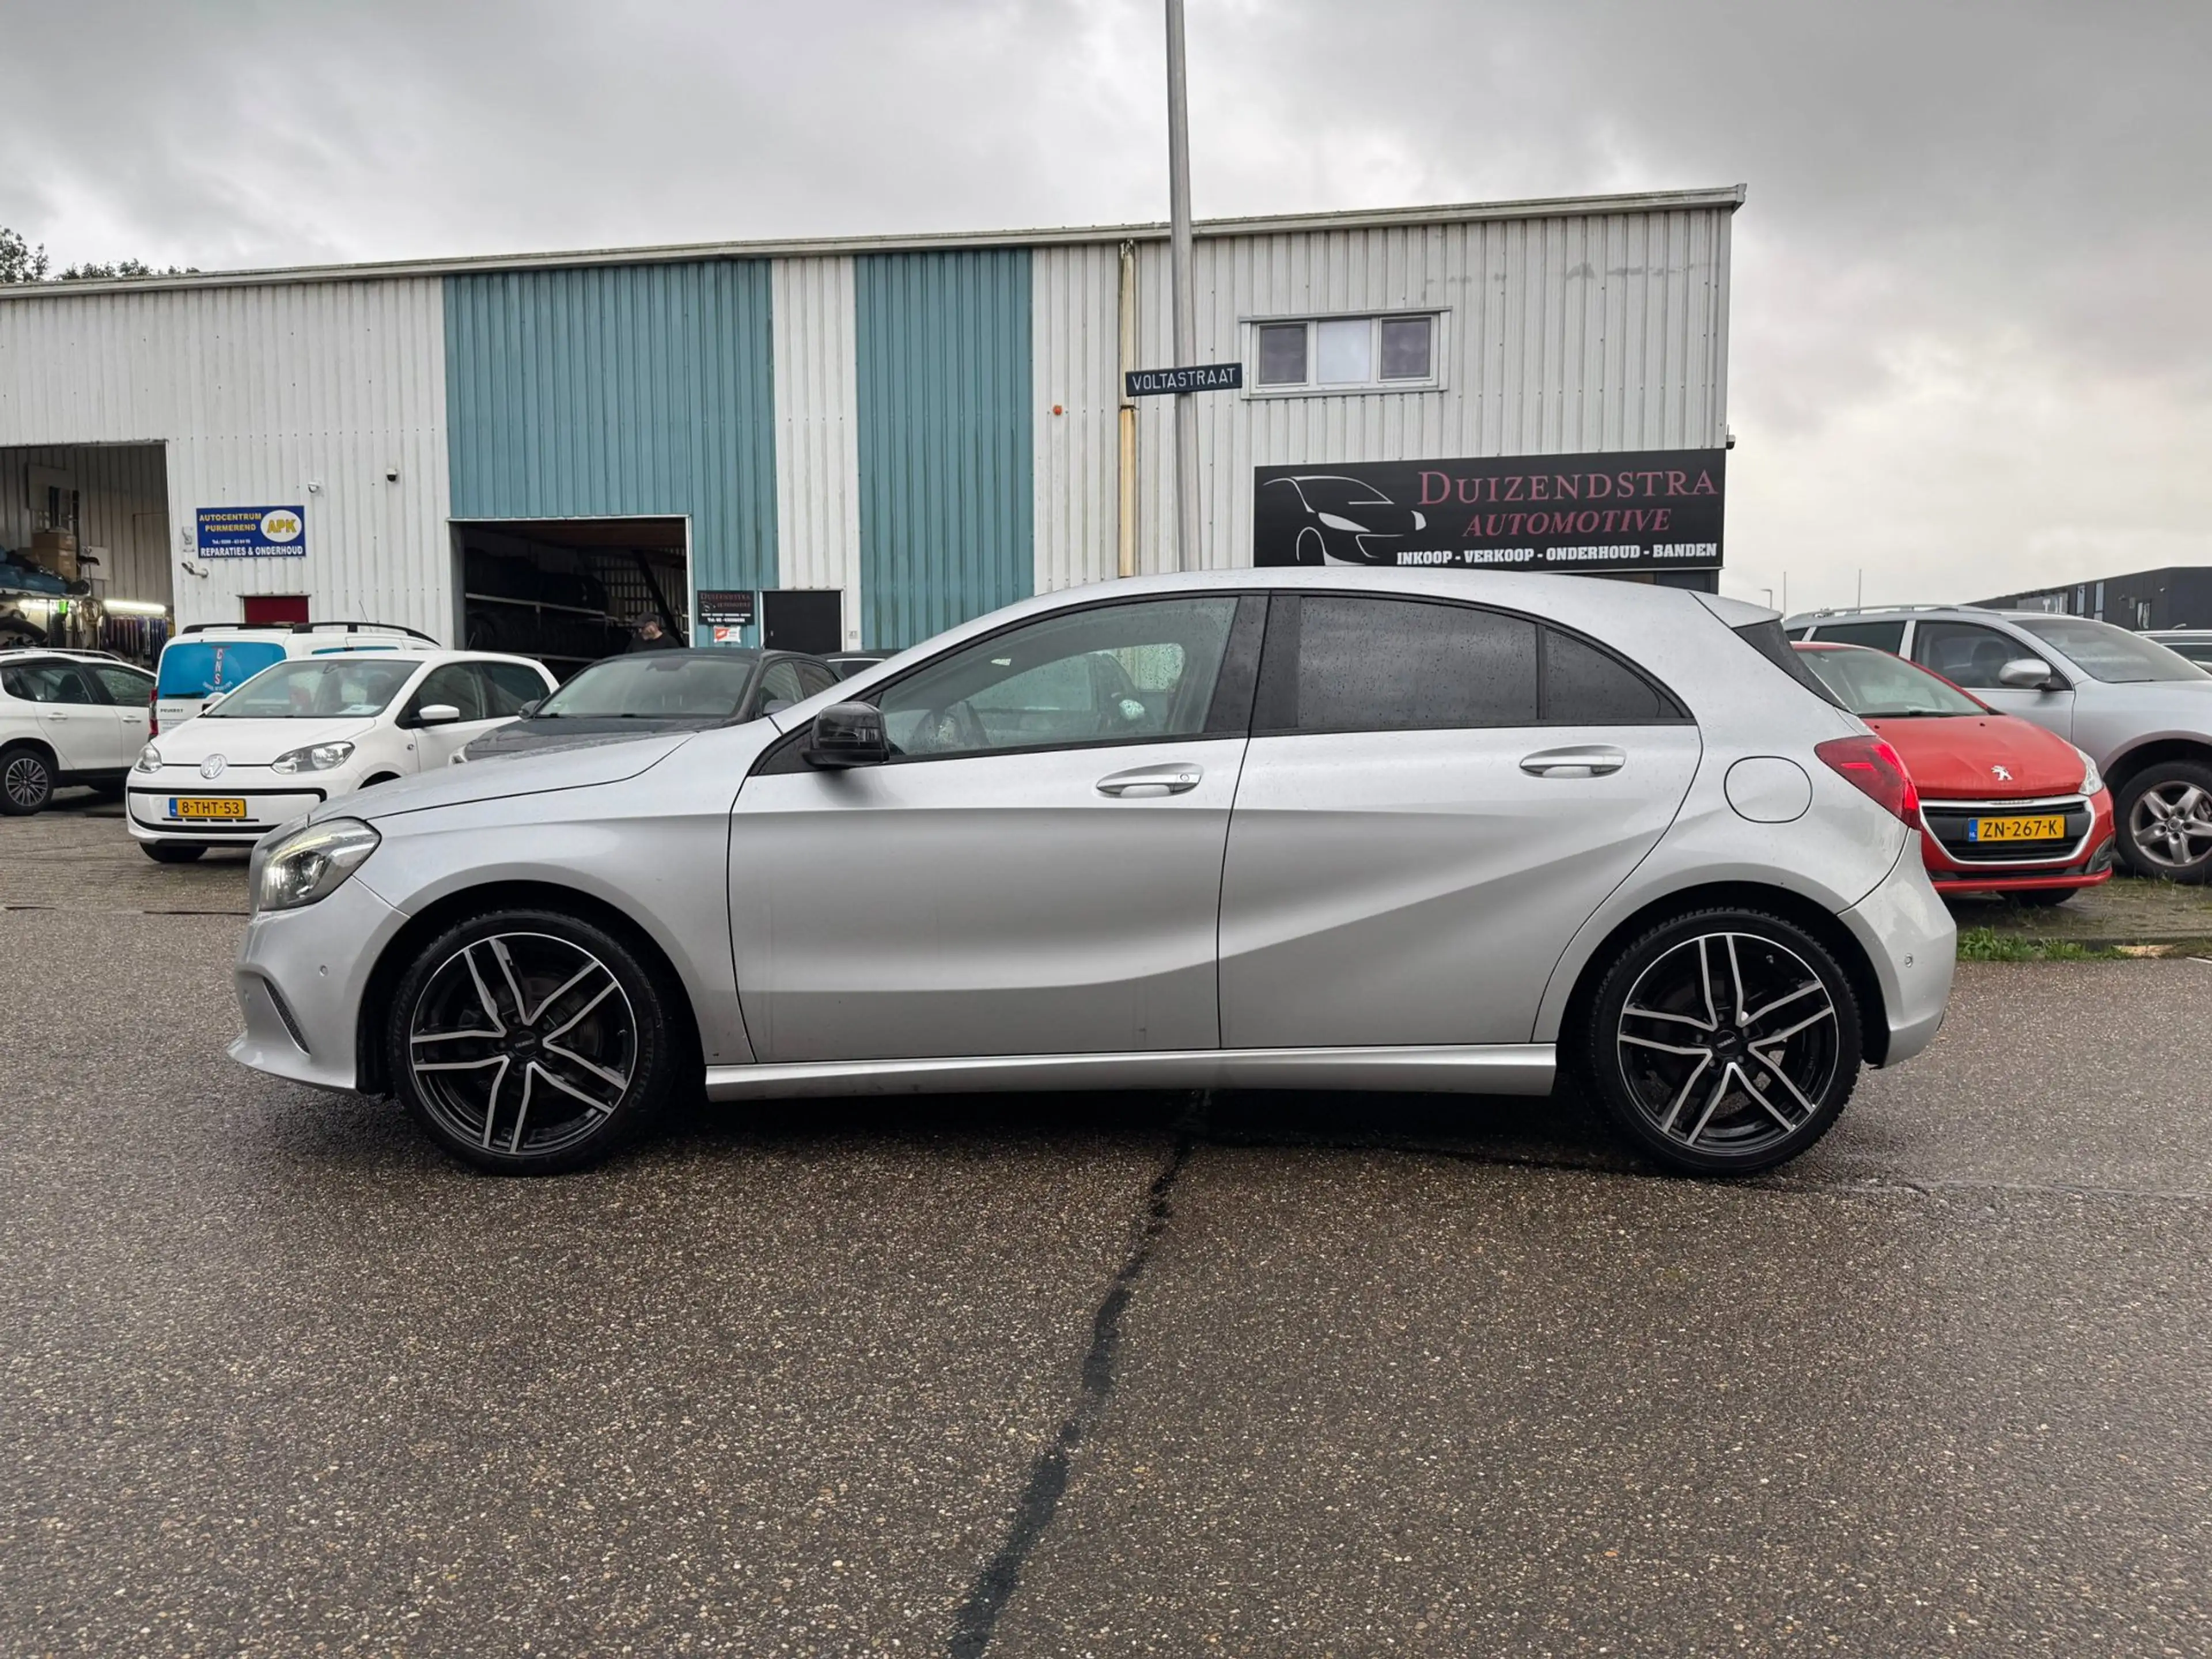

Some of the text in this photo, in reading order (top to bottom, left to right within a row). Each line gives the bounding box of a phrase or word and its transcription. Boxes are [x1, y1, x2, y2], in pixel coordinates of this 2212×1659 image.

[1132, 368, 1236, 391] VOLTASTRAAT
[1417, 469, 1719, 505] DUIZENDSTRA
[199, 512, 262, 522] AUTOCENTRUM
[1462, 508, 1672, 537] AUTOMOTIVE
[205, 523, 256, 533] PURMEREND
[266, 518, 297, 534] APK
[200, 546, 304, 556] REPARATIES & ONDERHOUD
[1396, 550, 1452, 566] INKOOP
[1464, 548, 1535, 563] VERKOOP
[1546, 544, 1641, 561] ONDERHOUD
[1653, 543, 1718, 558] BANDEN
[181, 801, 240, 814] 8-THT-53
[1983, 820, 2057, 838] ZN-267-K
